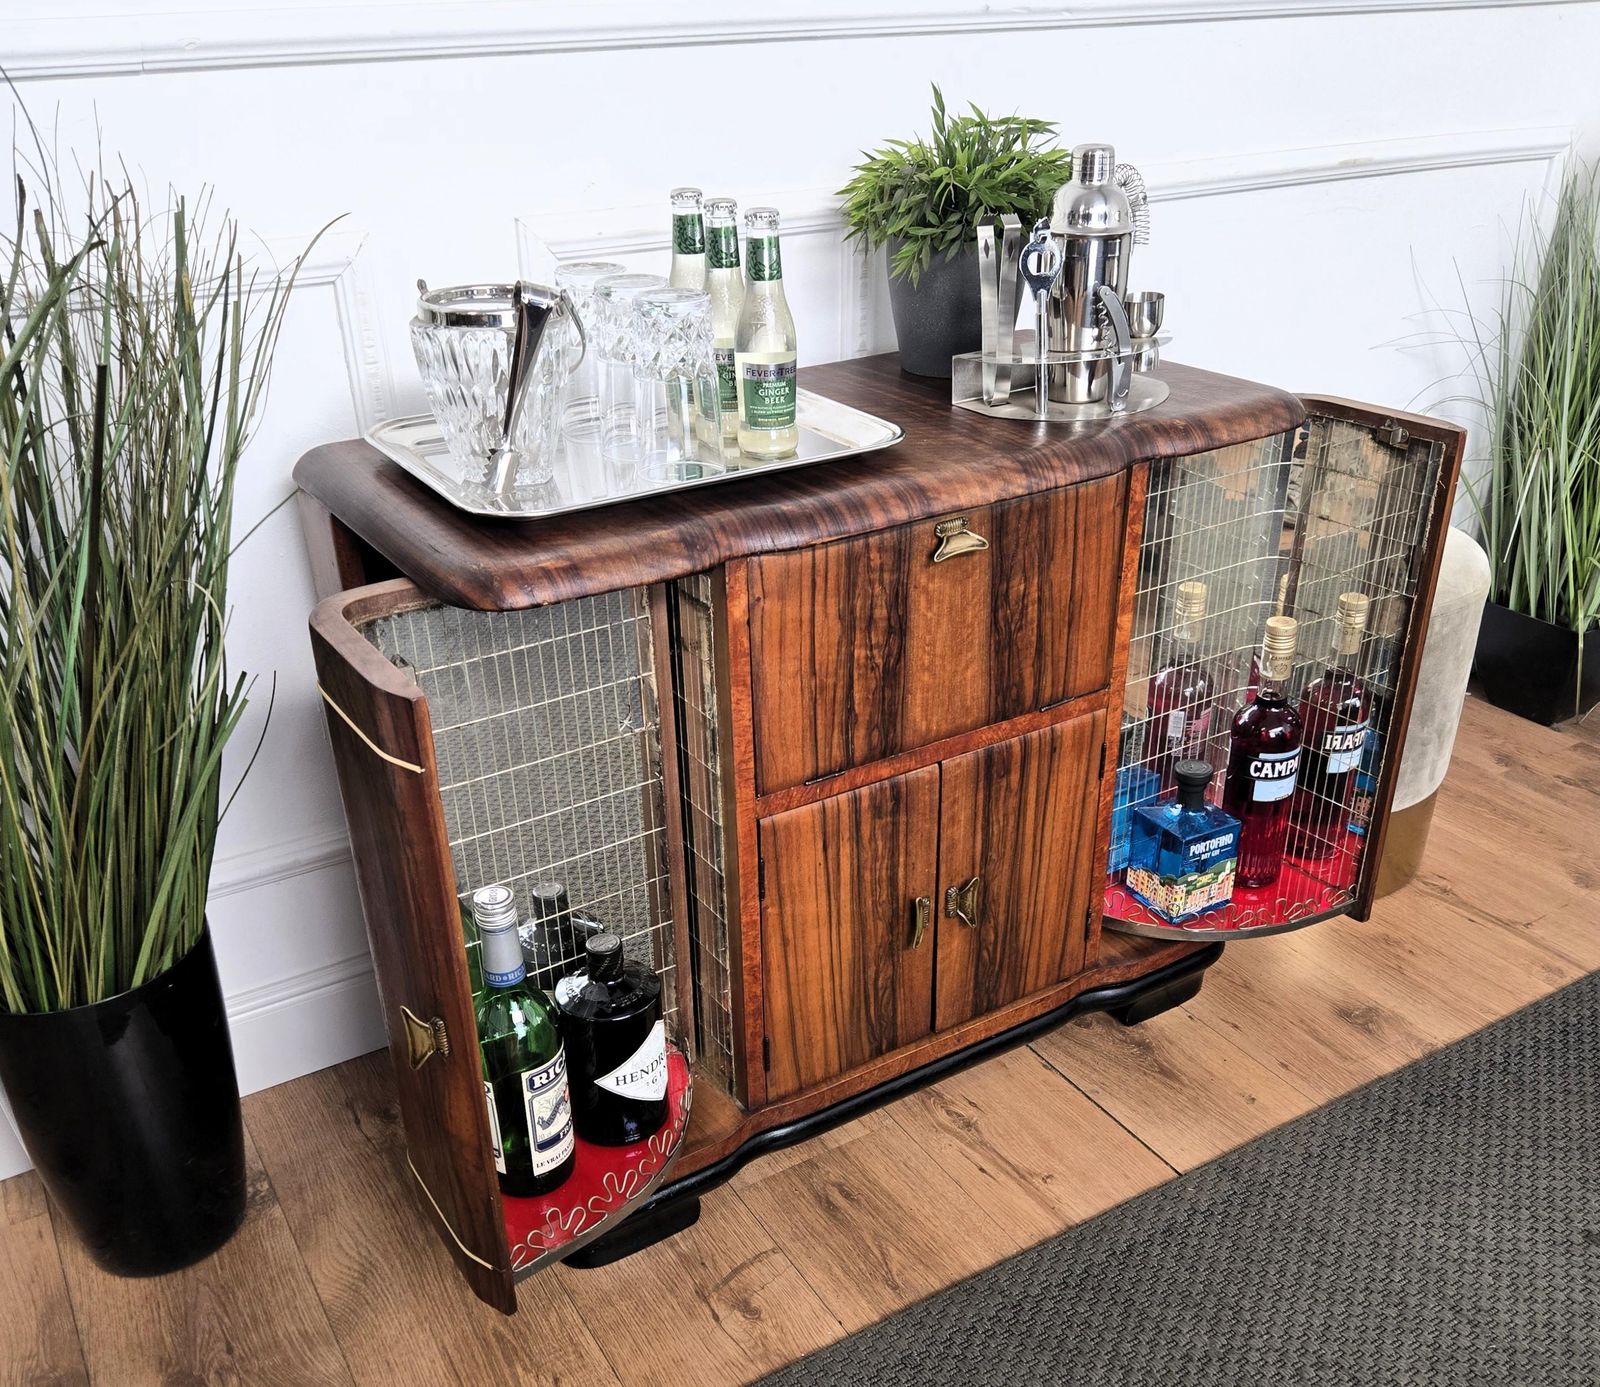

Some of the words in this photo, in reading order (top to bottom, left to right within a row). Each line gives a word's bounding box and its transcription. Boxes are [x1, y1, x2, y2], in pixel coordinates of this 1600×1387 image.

[758, 387, 790, 396] GINGER
[764, 396, 786, 404] BEER
[1189, 832, 1234, 857] PORTOFINO
